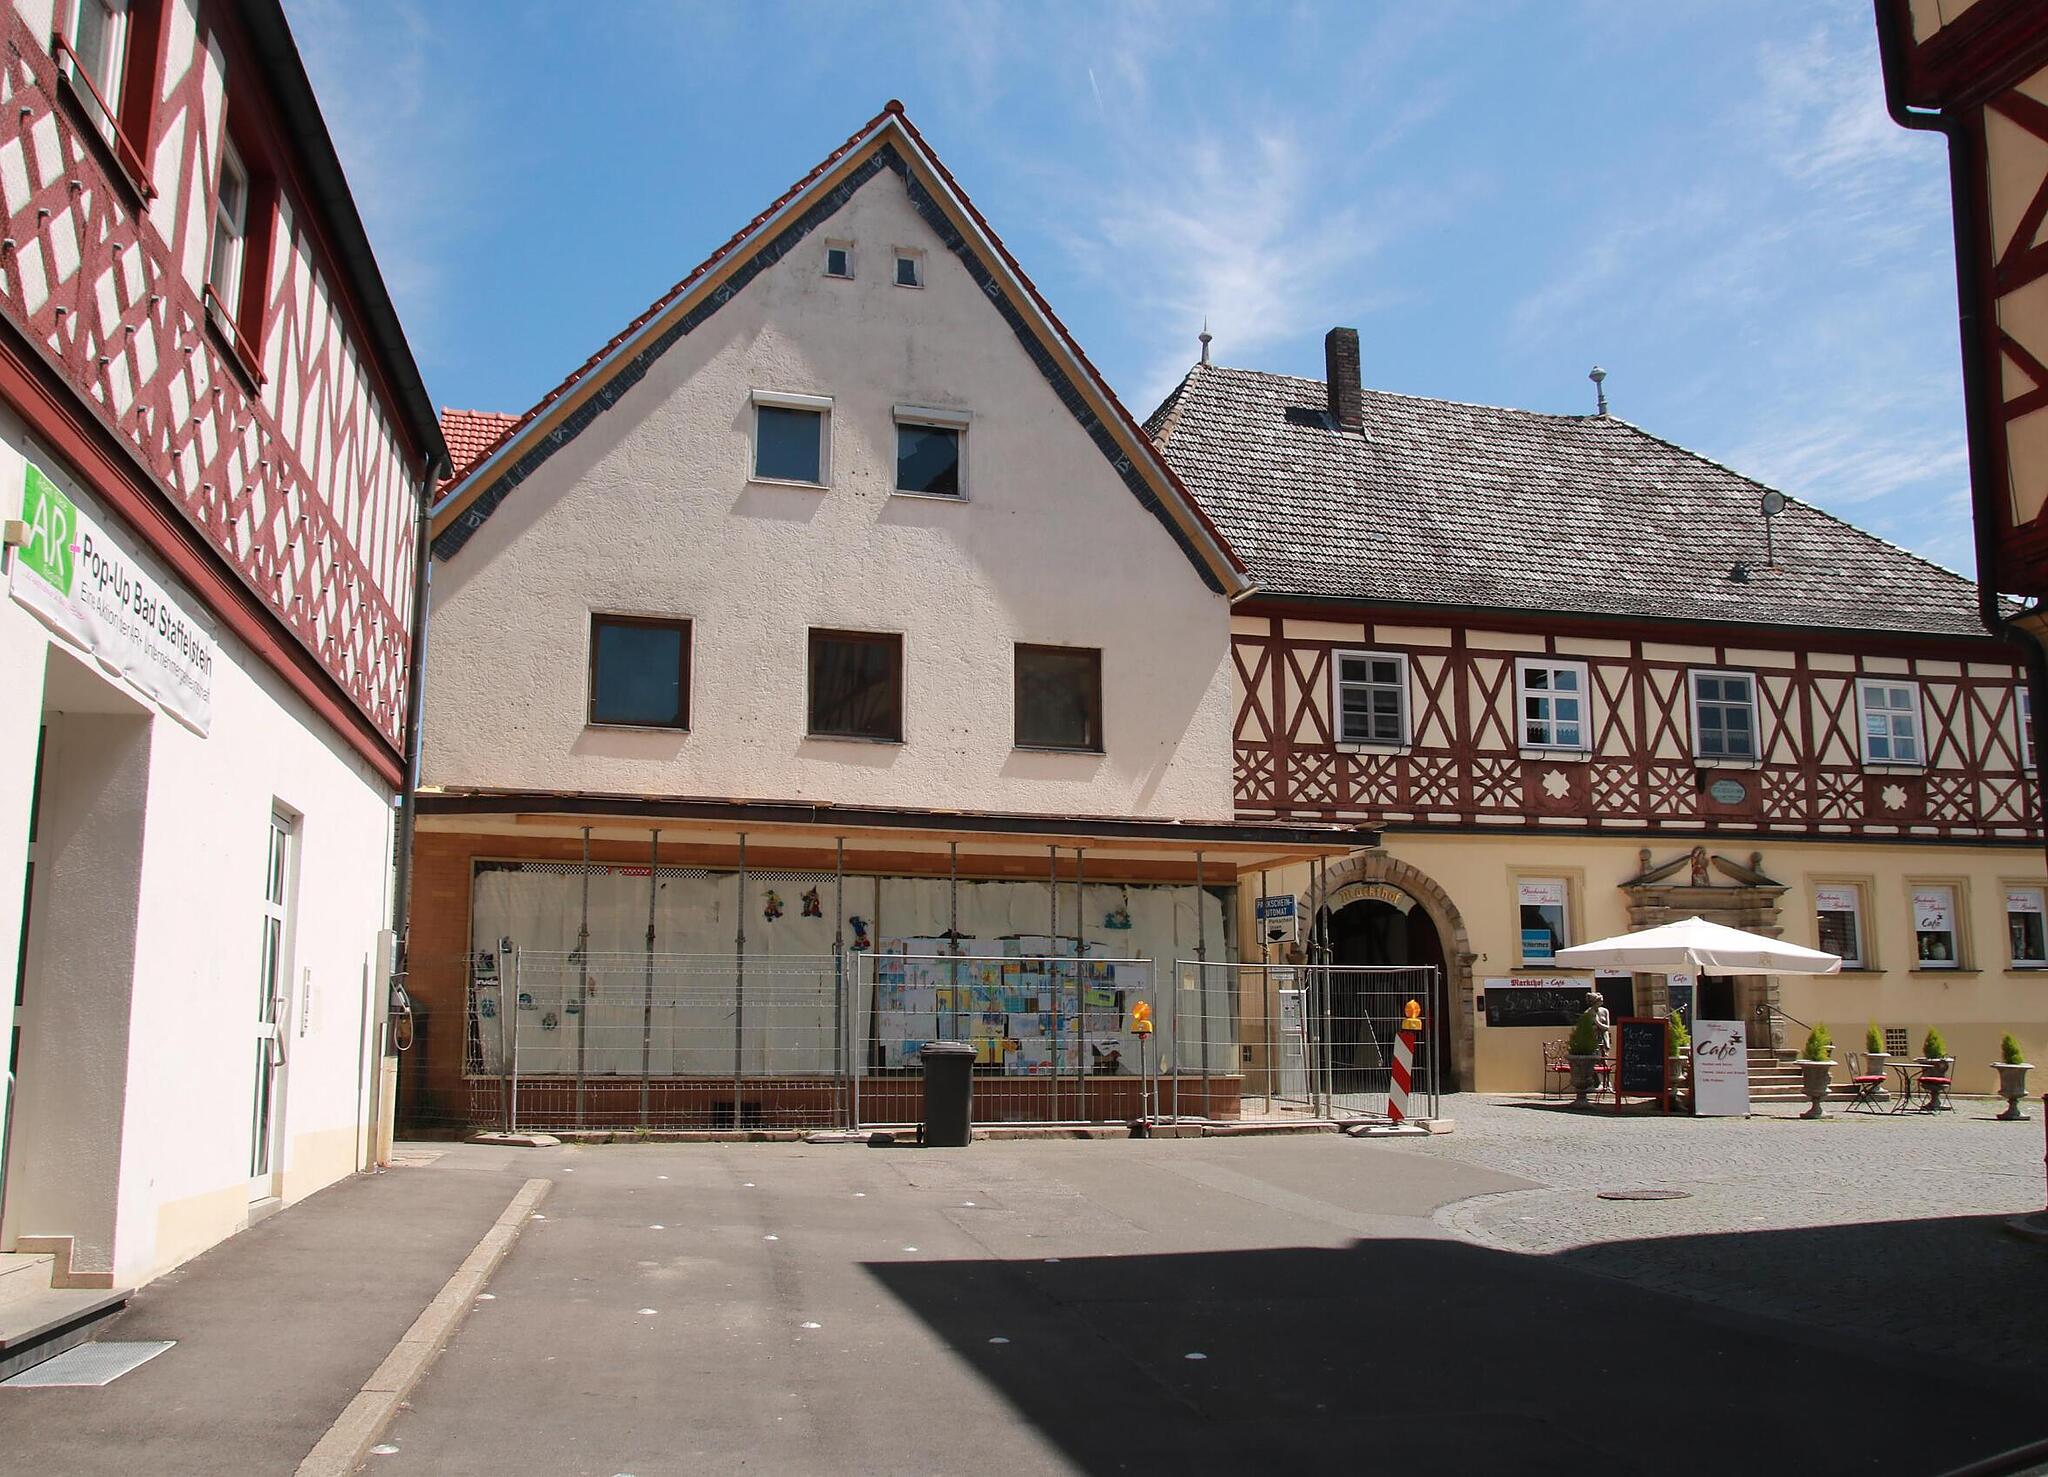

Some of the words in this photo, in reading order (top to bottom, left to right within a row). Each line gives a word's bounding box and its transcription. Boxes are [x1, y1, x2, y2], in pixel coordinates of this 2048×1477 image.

[82, 533, 131, 605] Pop-Up
[134, 581, 158, 628] Bad
[159, 604, 213, 678] Staffelstein
[1264, 907, 1287, 918] UTOMAT
[1482, 953, 1488, 962] 3
[1697, 1040, 1737, 1060] Café
